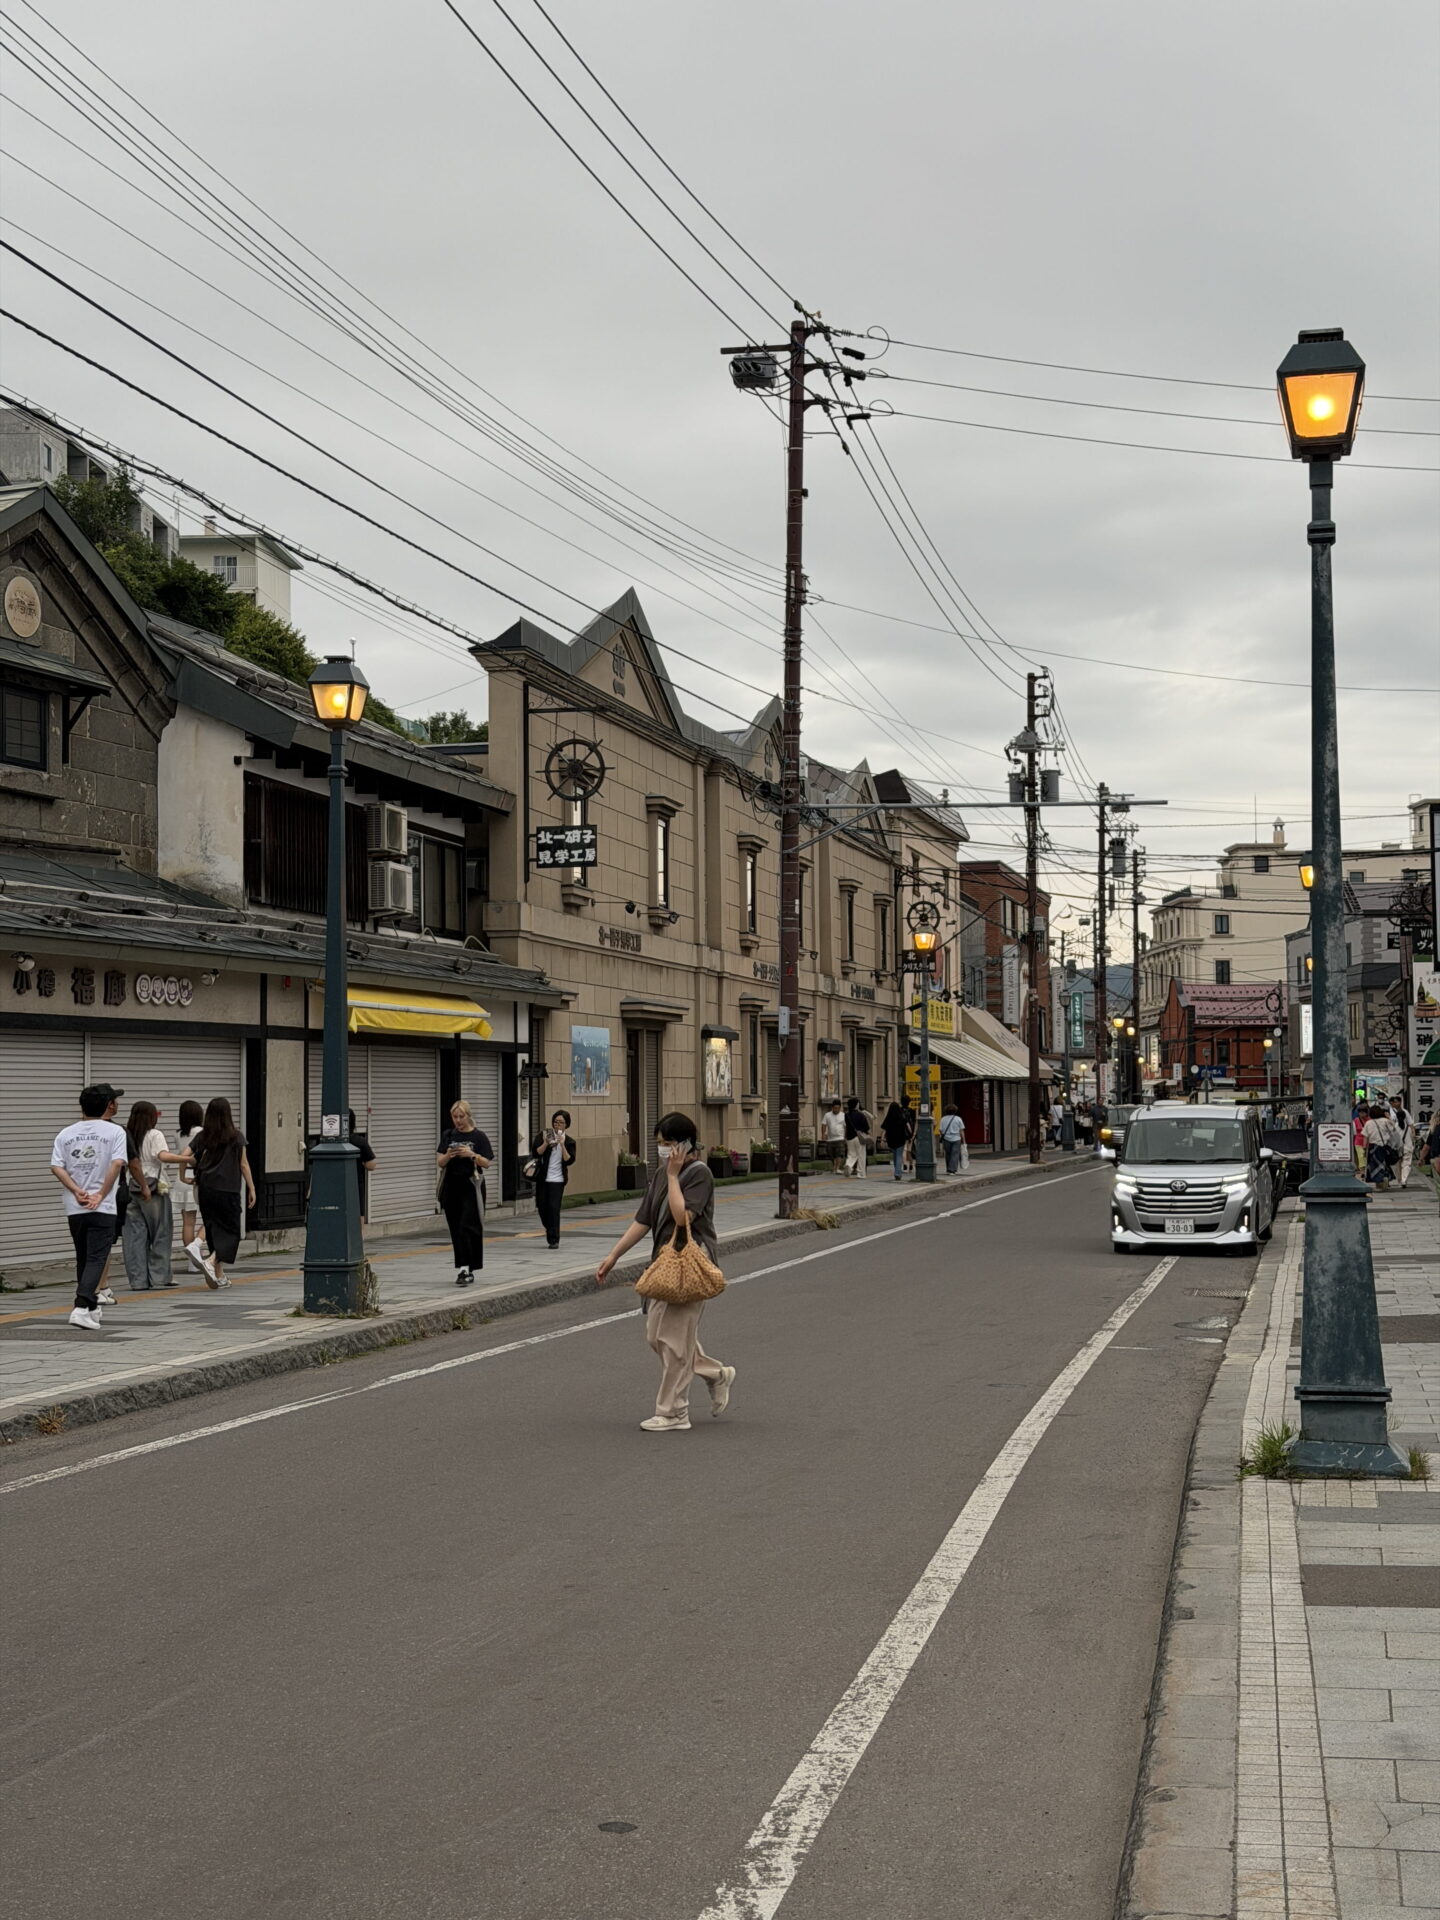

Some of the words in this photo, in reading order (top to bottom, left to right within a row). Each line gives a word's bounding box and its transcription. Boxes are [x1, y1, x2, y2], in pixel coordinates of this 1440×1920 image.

[537, 829, 596, 844] 北一硝子
[538, 848, 596, 864] 見学工房
[1356, 1080, 1365, 1089] P
